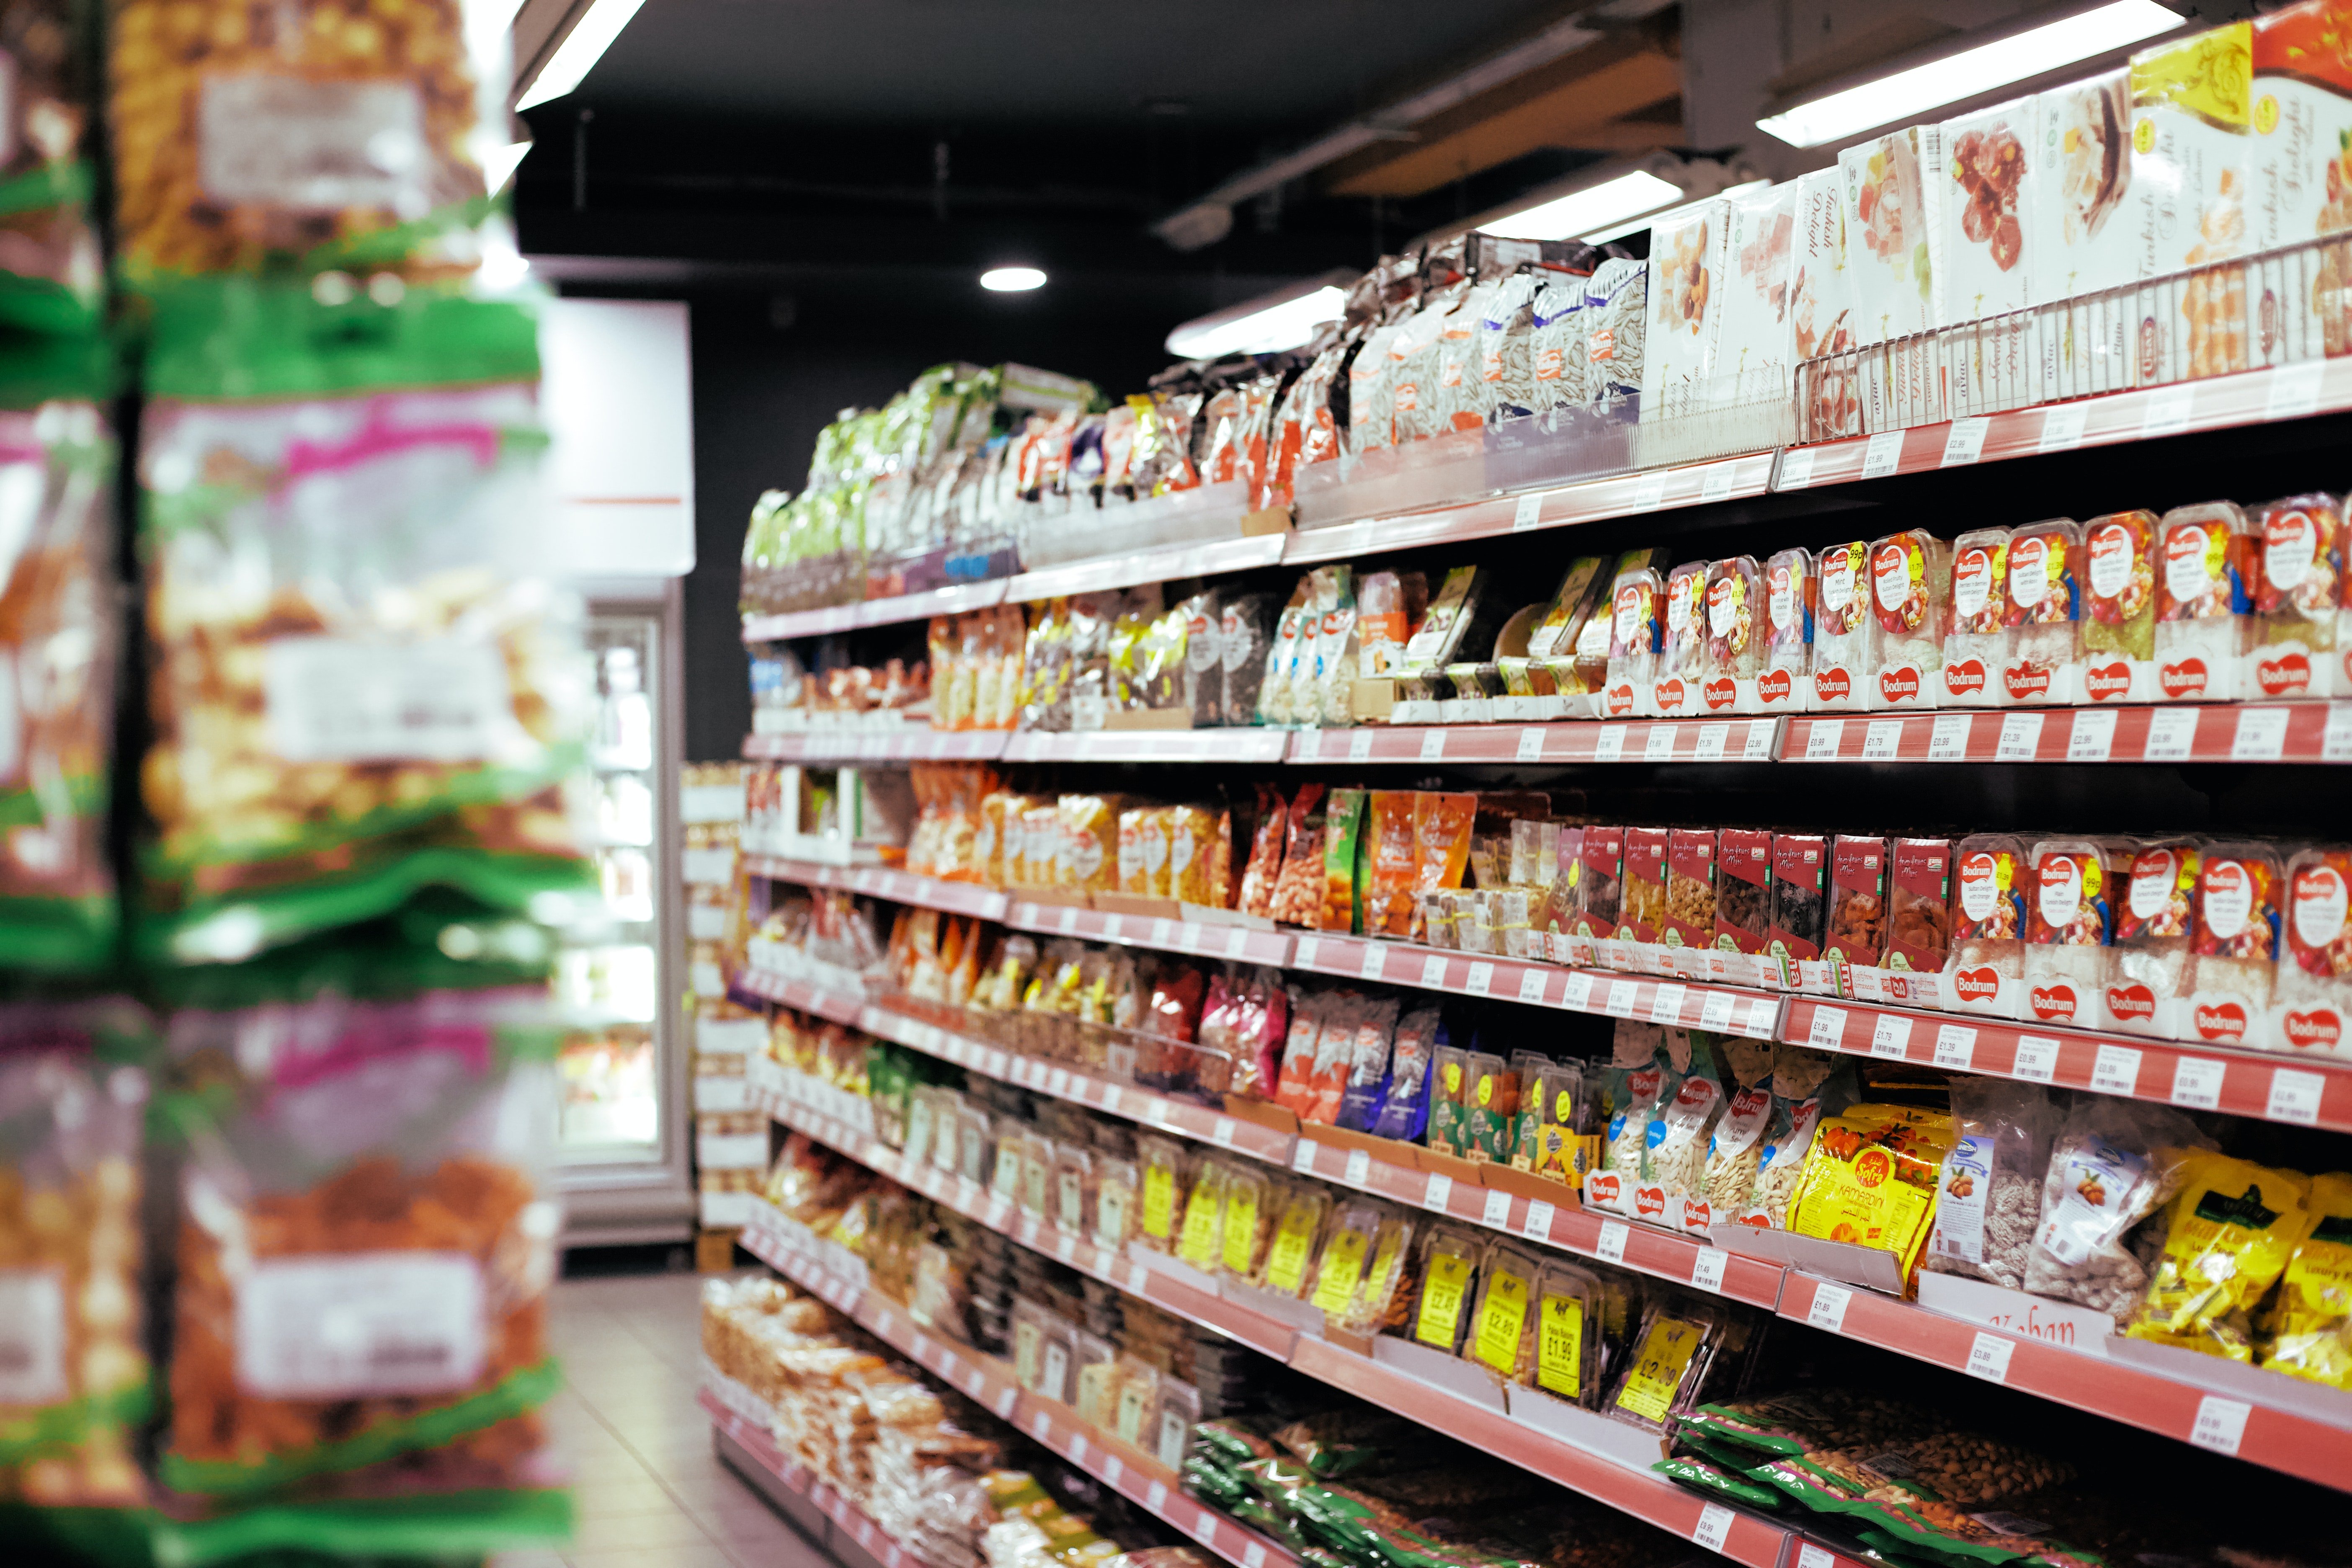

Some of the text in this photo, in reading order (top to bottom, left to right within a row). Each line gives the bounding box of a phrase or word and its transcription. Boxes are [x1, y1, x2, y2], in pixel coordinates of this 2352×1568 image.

[1824, 186, 1837, 250] Turkish
[1808, 191, 1822, 258] Delight
[1949, 440, 1965, 449] £2.99
[1867, 454, 1883, 464] £1.99
[1850, 549, 1862, 562] 99p
[2012, 551, 2040, 562] Bodrum
[1825, 560, 1847, 571] Bodrum
[1875, 558, 1899, 571] Bodrum
[1909, 563, 1922, 571] £1.79
[1957, 563, 1982, 573] Bodrum
[2047, 562, 2063, 570] £1.39
[1771, 579, 1787, 590] Bodrum
[1709, 589, 1729, 601] Bodrum
[1947, 670, 1983, 686] Bodrum
[2007, 673, 2048, 690] Bodrum
[2089, 672, 2129, 691] Bodrum
[2164, 671, 2205, 687] Bodrum
[2261, 667, 2308, 684] Bodrum
[1759, 679, 1789, 695] Bodrum
[1817, 677, 1848, 694] Bodrum
[1883, 678, 1917, 694] Bodrum
[1609, 693, 1632, 707] Bodrum
[1657, 689, 1682, 702] Bodrum
[1706, 688, 1734, 701] Bodrum
[1810, 738, 1825, 746] £0.99
[1933, 738, 1950, 747] £0.99
[2003, 733, 2021, 743] £1.39
[2073, 735, 2092, 744] £2.99
[1723, 845, 1749, 857] dried fruits
[1777, 848, 1803, 859] dried fruits
[1728, 856, 1742, 867] Nuts
[1781, 859, 1795, 872] Nuts
[1849, 854, 1863, 865] fruits
[1910, 855, 1926, 867] fruits
[1842, 865, 1854, 877] Nuts
[1963, 865, 1990, 876] Bodrum
[2136, 861, 2166, 872] Bodrum
[1904, 867, 1917, 879] Nuts
[1996, 872, 2009, 881] £1.39
[2042, 869, 2070, 879] Bodrum
[2086, 877, 2100, 890] 99p
[1958, 978, 1996, 994] Bodrum
[1656, 1001, 1668, 1009] £2.09
[2033, 994, 2074, 1013] Bodrum
[2110, 994, 2153, 1013] Bodrum
[1705, 1007, 1717, 1016] £2.69
[1751, 1014, 1764, 1023] £1.79
[2199, 1012, 2244, 1031] Bodrum
[1813, 1021, 1828, 1032] £1.99
[2289, 1019, 2338, 1039] Bodrum
[1877, 1030, 1892, 1041] £1.79
[1939, 1041, 1955, 1052] £1.39
[2019, 1053, 2036, 1064] £0.99
[1858, 1163, 1883, 1183] Sofra
[1592, 1182, 1618, 1197] Bodrum
[1638, 1194, 1663, 1210] Bodrum
[1839, 1184, 1884, 1209] KAMARDIN
[1697, 1264, 1710, 1273] £1.49
[1814, 1301, 1830, 1312] £1.89
[1547, 1336, 1572, 1362] £1.99
[1973, 1349, 1991, 1362] £3.89
